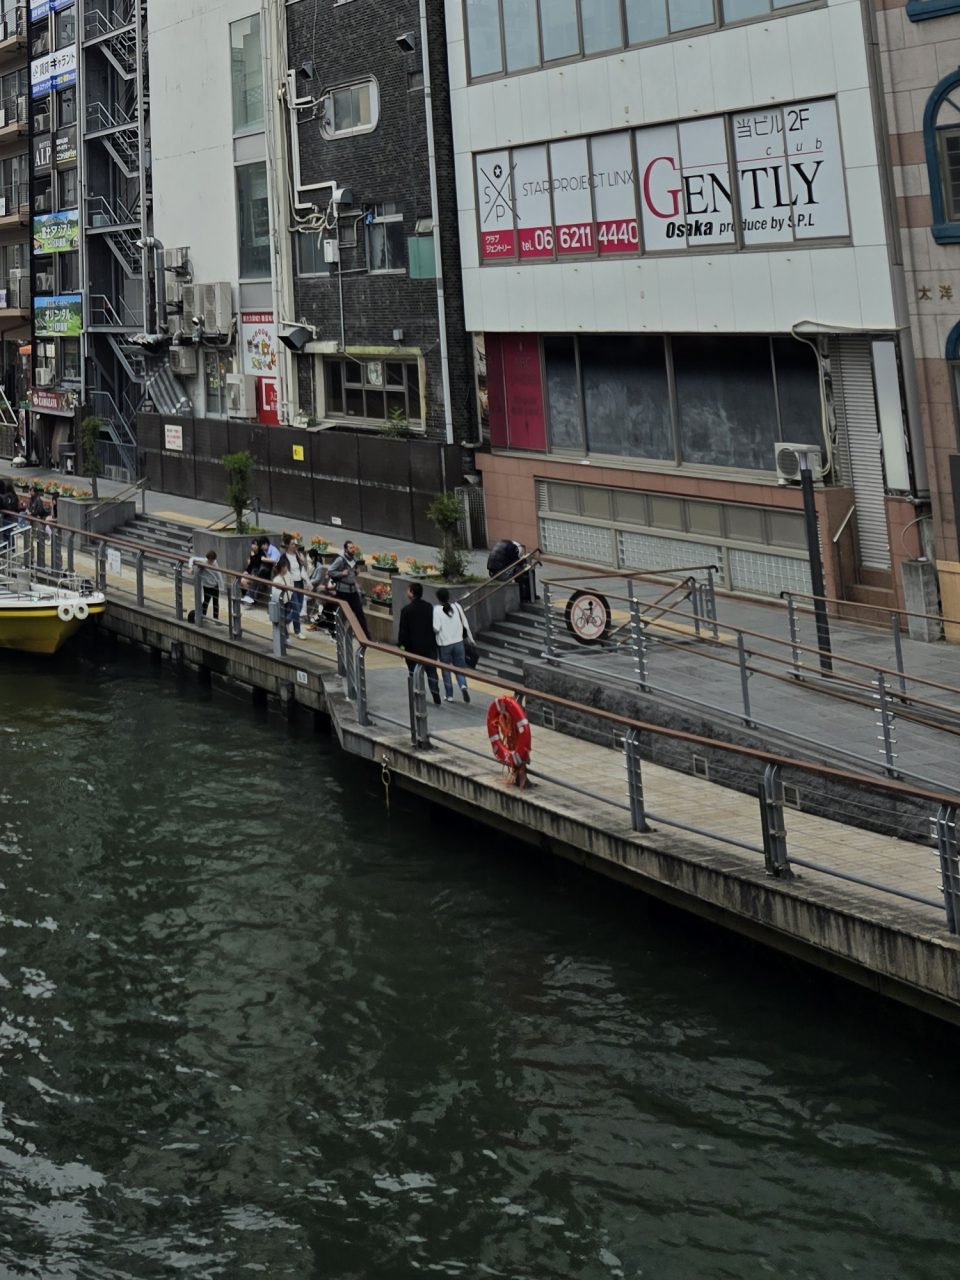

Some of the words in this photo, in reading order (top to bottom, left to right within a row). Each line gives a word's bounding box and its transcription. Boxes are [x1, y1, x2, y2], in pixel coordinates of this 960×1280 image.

[737, 114, 783, 138] 当ビル
[788, 108, 810, 132] 2F
[522, 180, 551, 197] STAR
[552, 172, 606, 193] PROJECT
[608, 169, 635, 187] LINX
[643, 157, 825, 219] GENTLY
[485, 234, 500, 243] クラブ
[534, 229, 554, 250] 06
[560, 226, 592, 249] 6211
[598, 221, 640, 246] 4440
[666, 220, 714, 239] Osaka
[771, 215, 785, 231] by
